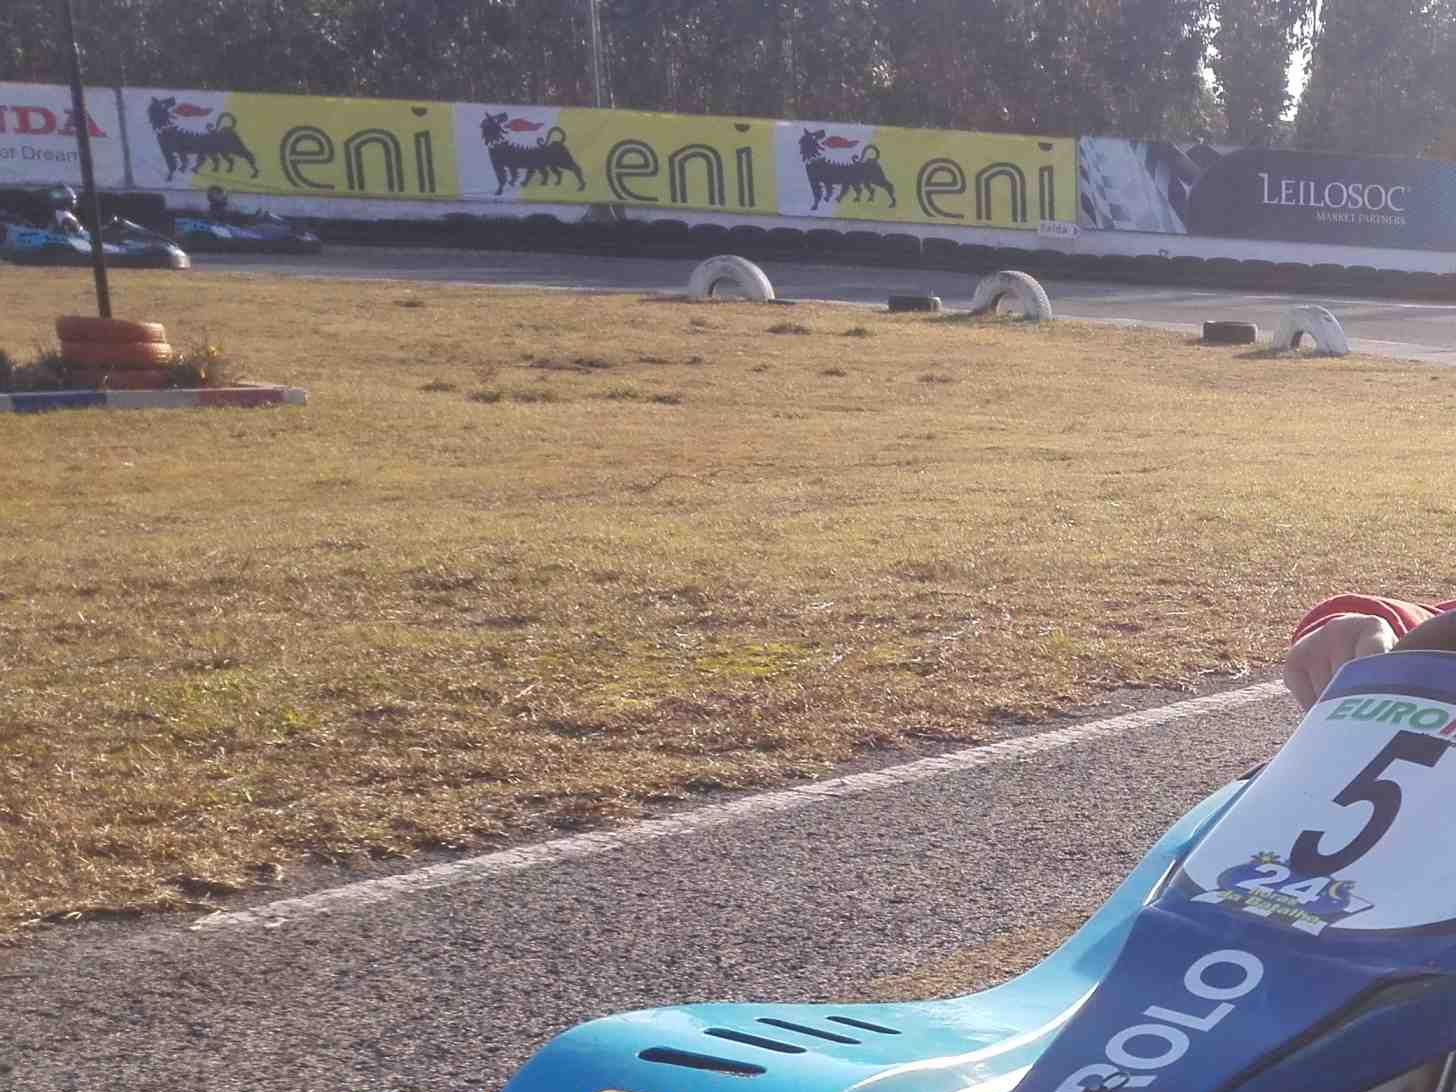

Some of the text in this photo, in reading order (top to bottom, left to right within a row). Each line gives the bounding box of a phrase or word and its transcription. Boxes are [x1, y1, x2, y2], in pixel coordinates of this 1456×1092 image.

[279, 106, 437, 194] eni
[606, 123, 757, 208] eni
[916, 142, 1055, 223] eni
[1290, 729, 1451, 877] 5
[1236, 863, 1332, 904] 24
